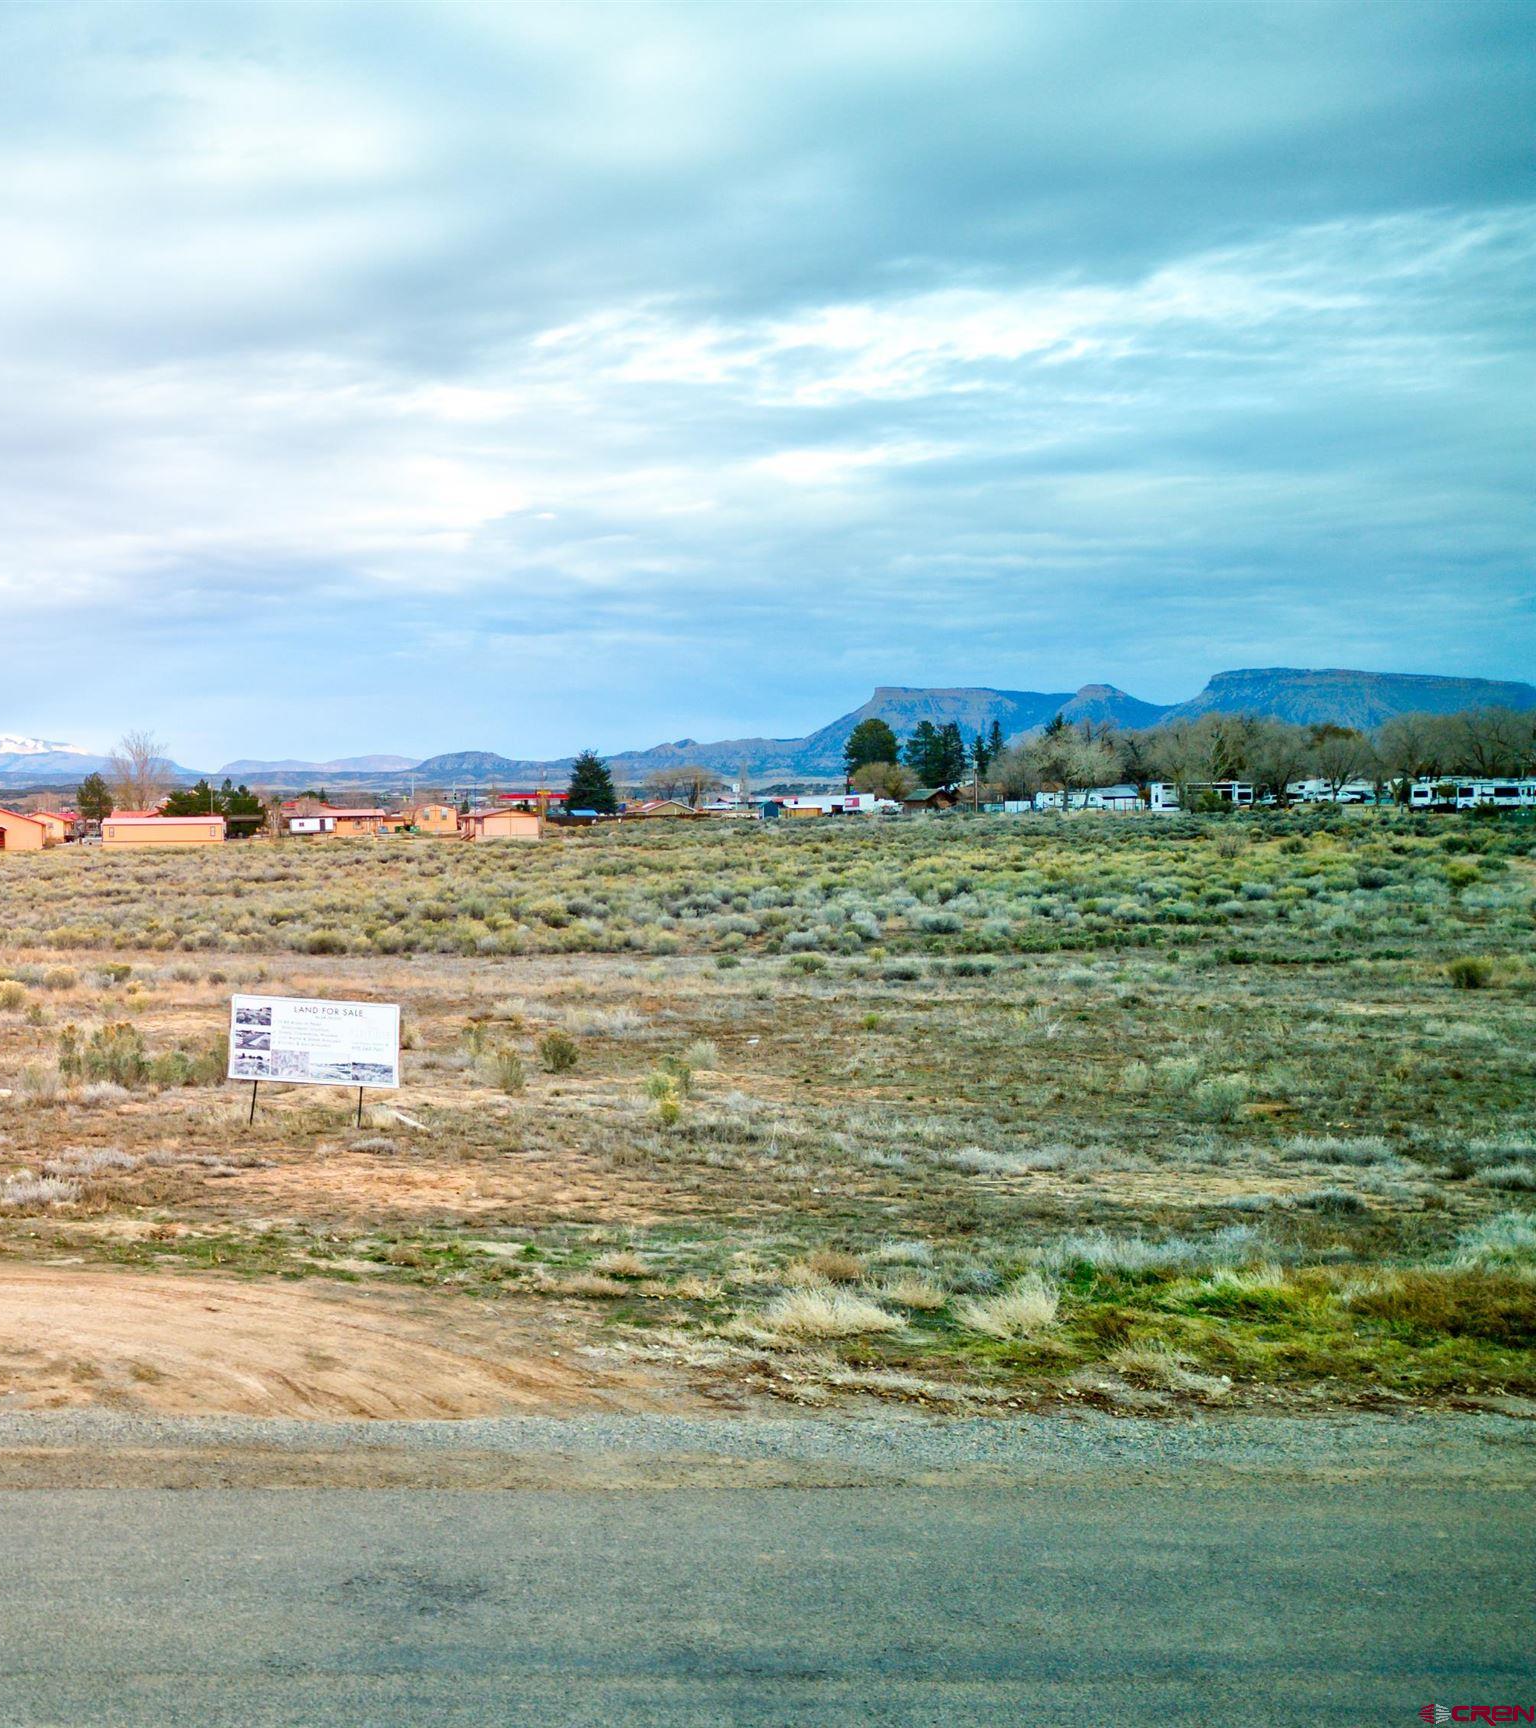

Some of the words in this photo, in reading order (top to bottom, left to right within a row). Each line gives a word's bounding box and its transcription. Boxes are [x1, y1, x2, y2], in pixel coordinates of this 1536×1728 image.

[294, 1006, 318, 1014] LAND
[322, 1007, 339, 1015] FOR
[342, 1008, 363, 1017] SALE
